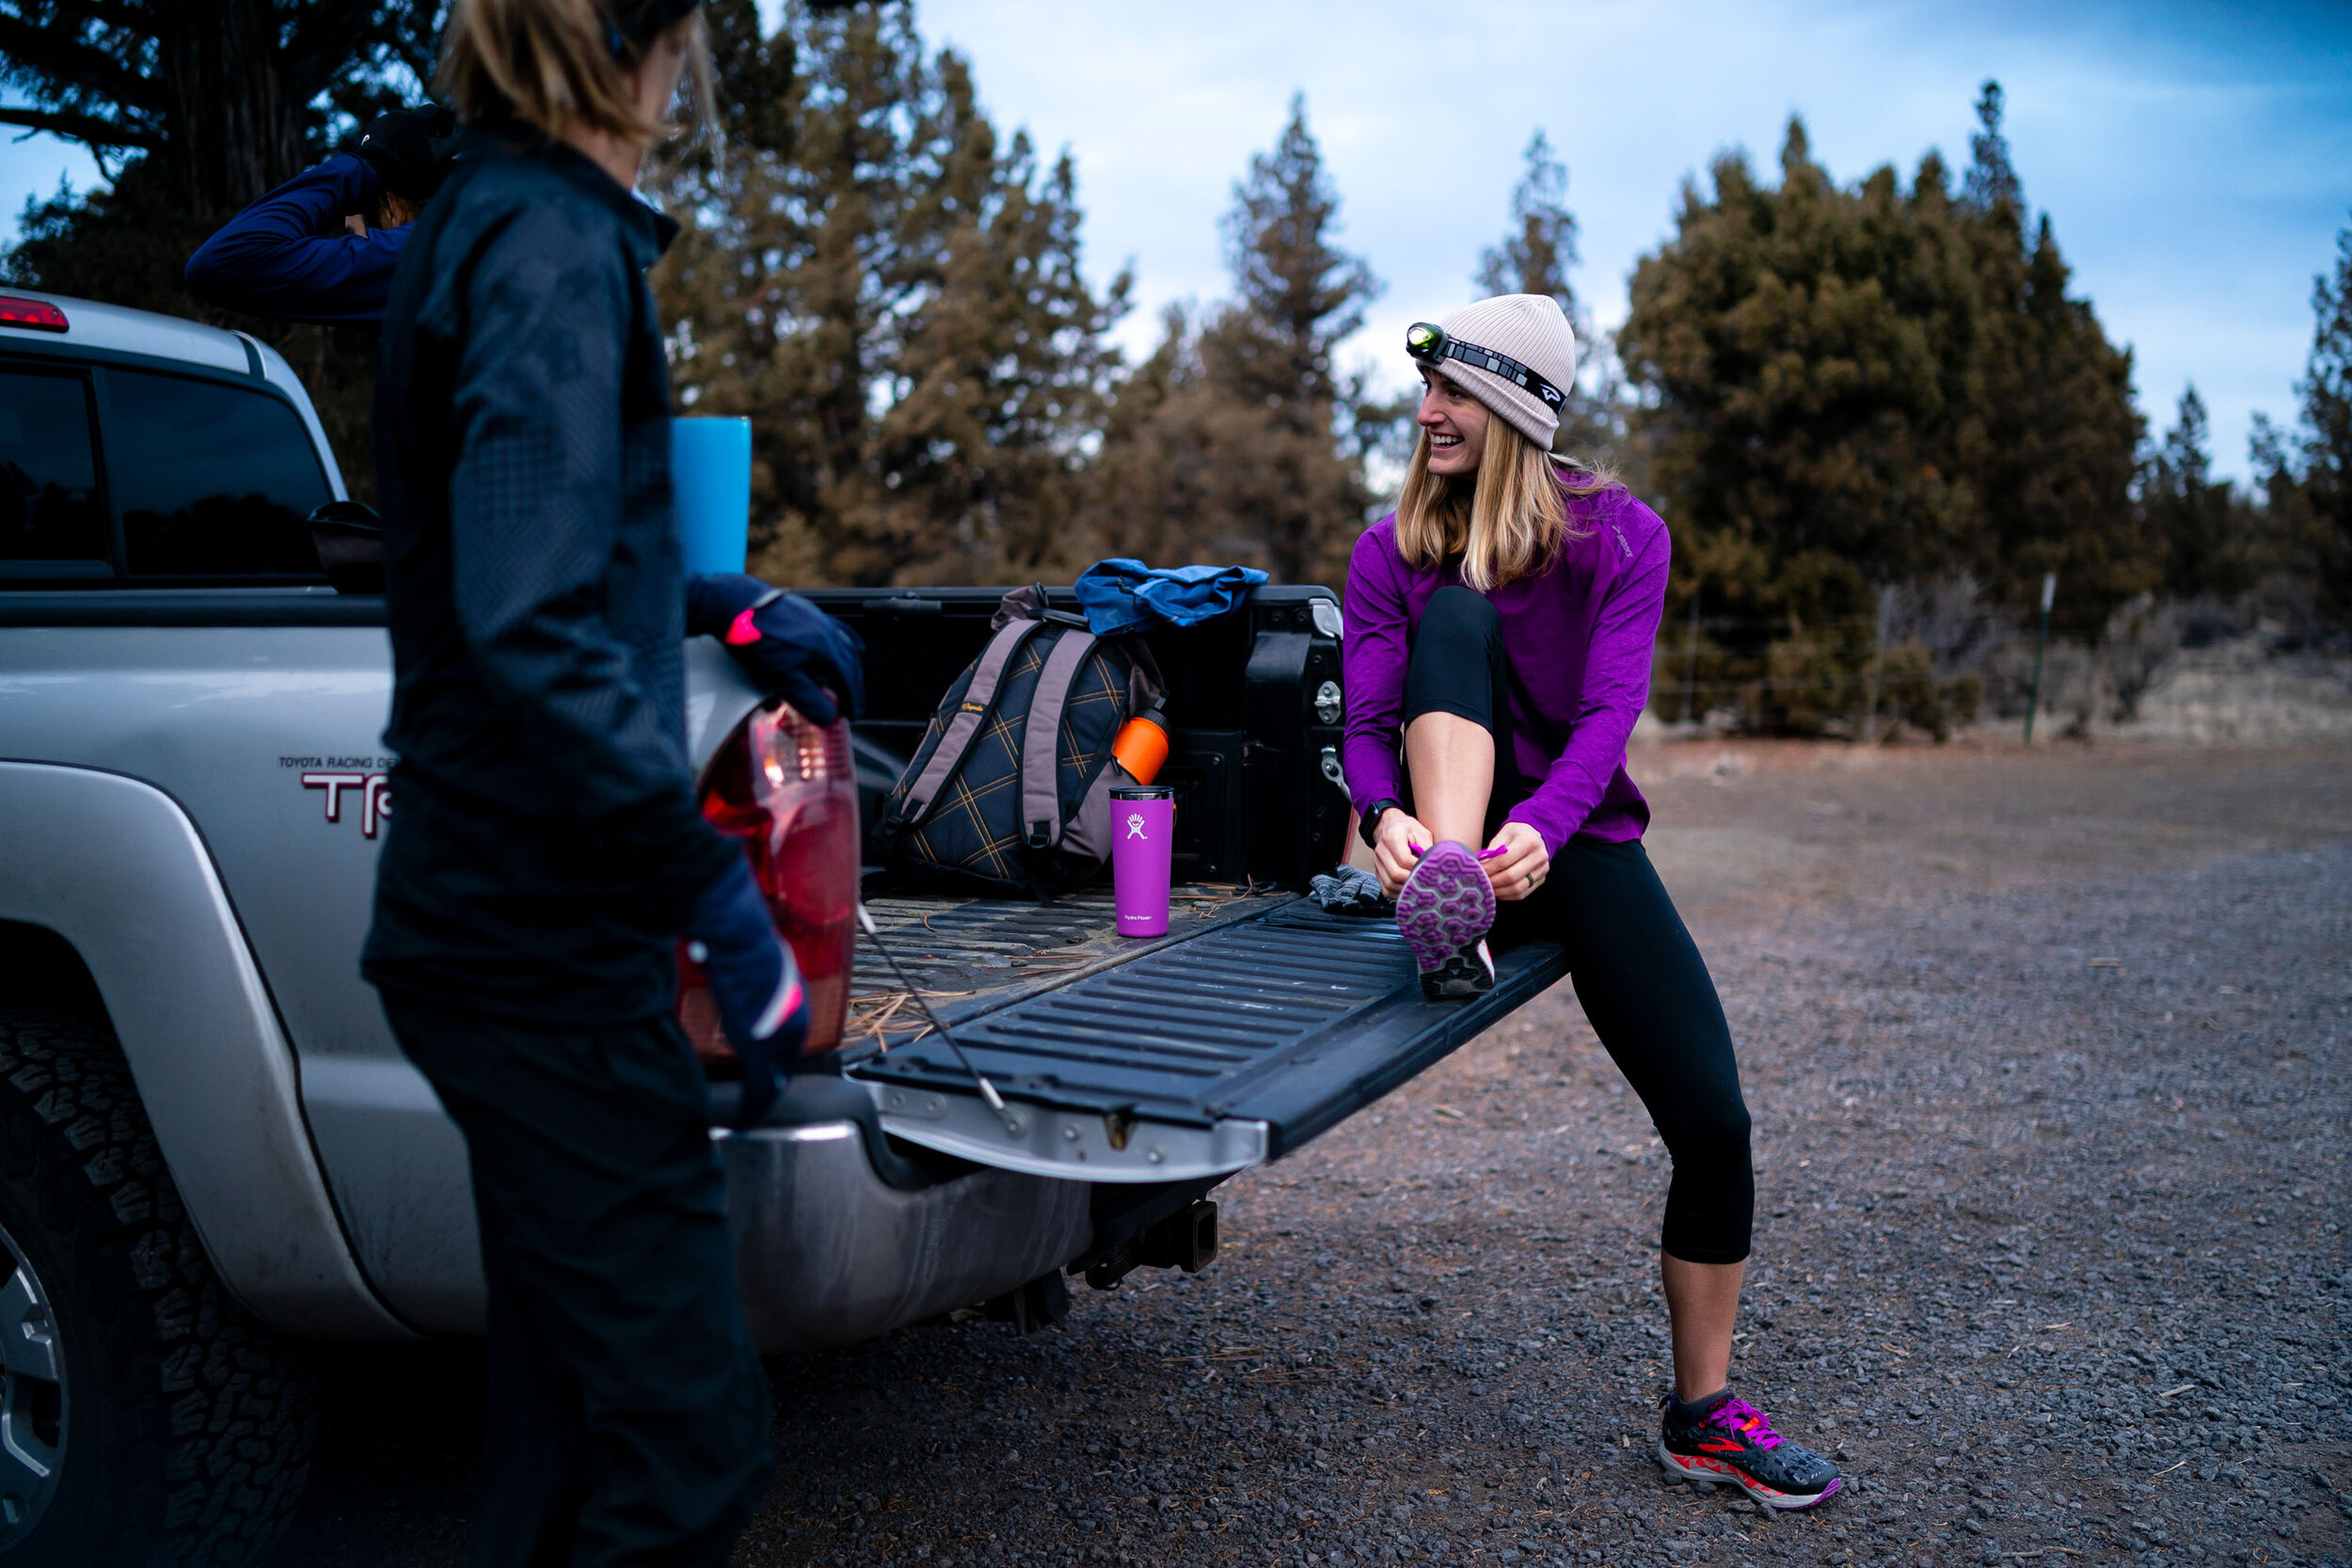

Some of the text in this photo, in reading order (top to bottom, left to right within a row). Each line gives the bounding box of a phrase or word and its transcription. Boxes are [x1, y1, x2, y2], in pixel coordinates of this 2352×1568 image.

[1617, 534, 1633, 558] BROOKS
[279, 757, 323, 768] TOYOTA
[326, 757, 373, 768] RACING
